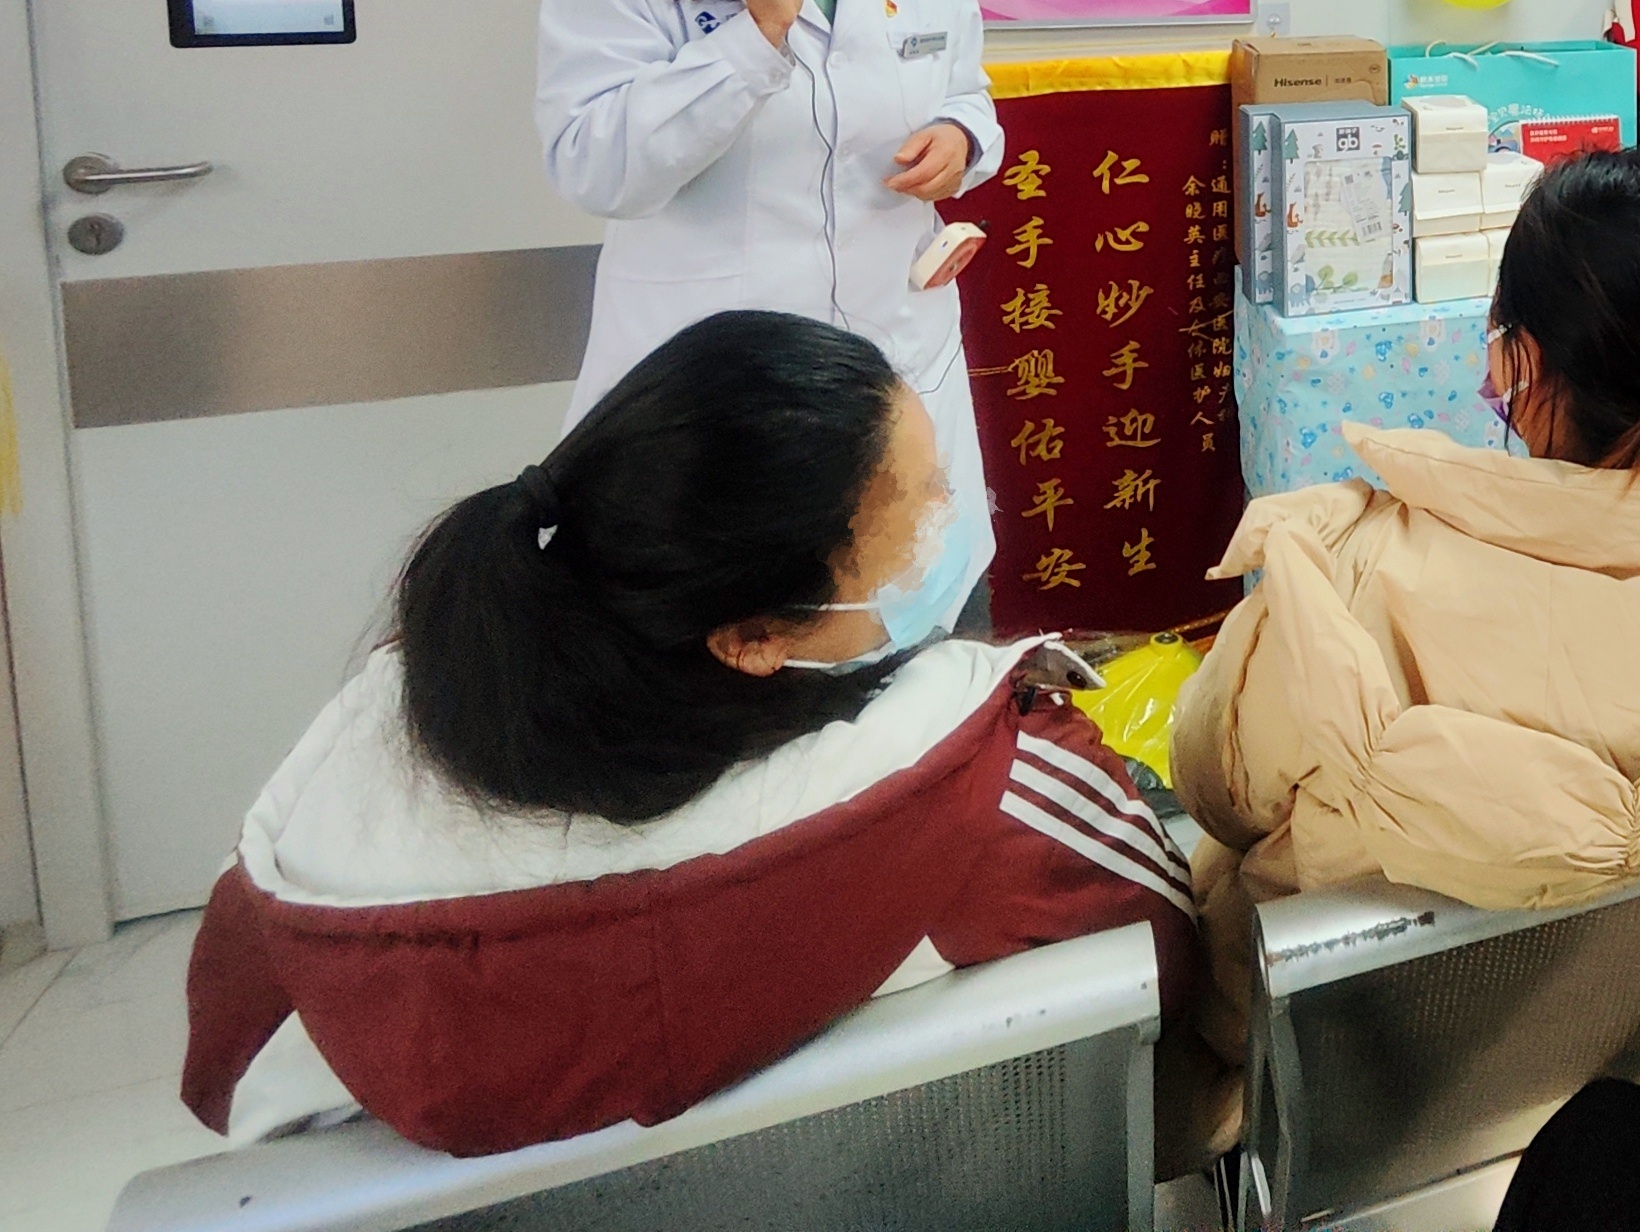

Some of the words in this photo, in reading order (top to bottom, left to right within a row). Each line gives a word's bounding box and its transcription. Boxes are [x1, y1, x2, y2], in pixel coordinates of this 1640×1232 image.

[1274, 78, 1322, 87] Hisense
[1338, 133, 1359, 152] gb
[1000, 149, 1088, 591] 圣手接婴佑平安
[1092, 149, 1162, 576] 仁心妙手迎新生
